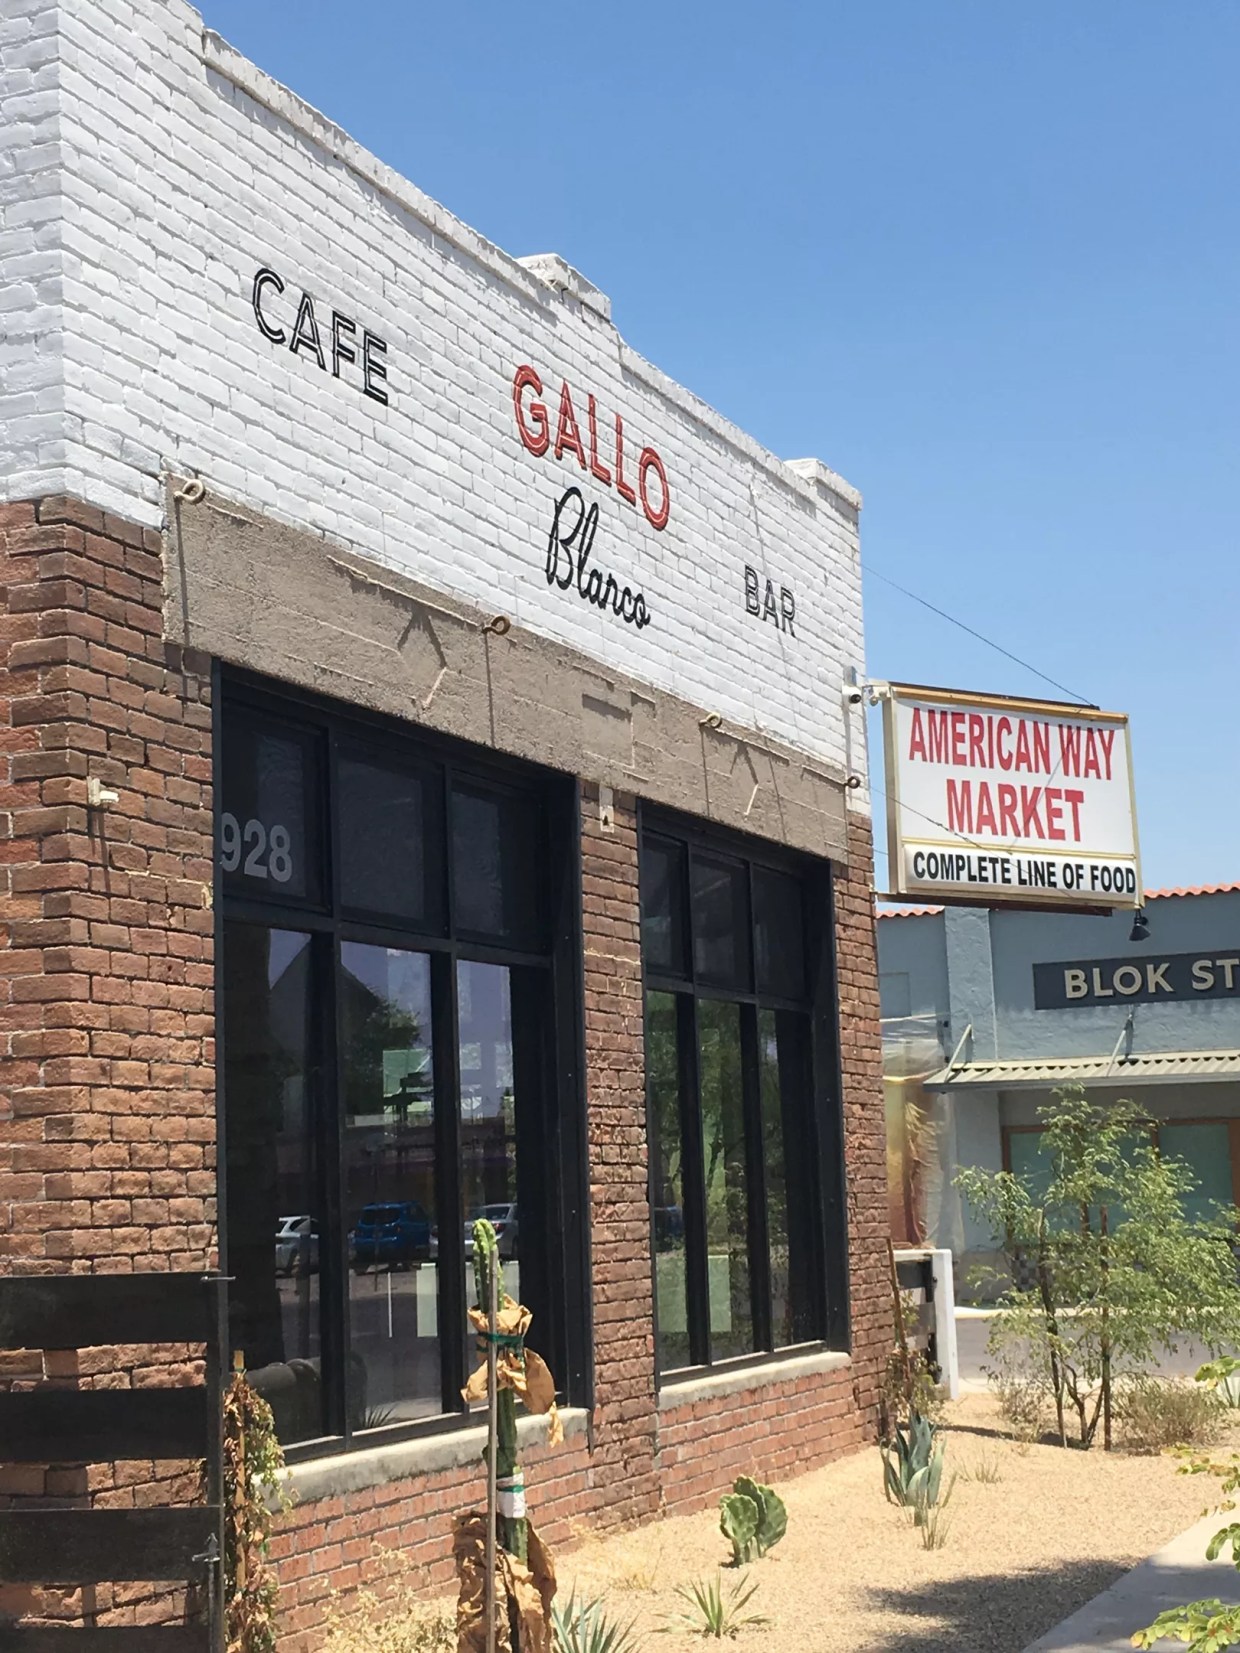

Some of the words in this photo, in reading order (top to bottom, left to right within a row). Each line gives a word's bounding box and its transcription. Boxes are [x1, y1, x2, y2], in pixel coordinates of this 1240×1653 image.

[253, 267, 389, 406] CAFE
[512, 364, 670, 531] GALLO
[545, 486, 650, 629] Blanco
[744, 564, 796, 637] BAR
[909, 707, 1051, 775] AMERICAN
[1058, 723, 1115, 781] WAY
[946, 778, 1084, 842] MARKET
[221, 812, 292, 882] 928
[913, 850, 1012, 884] COMPLETE
[1017, 859, 1057, 888] LINE
[1062, 863, 1084, 890] OF
[1090, 865, 1136, 893] FOOD
[1064, 963, 1174, 999] BLOK
[1191, 958, 1240, 990] ST
